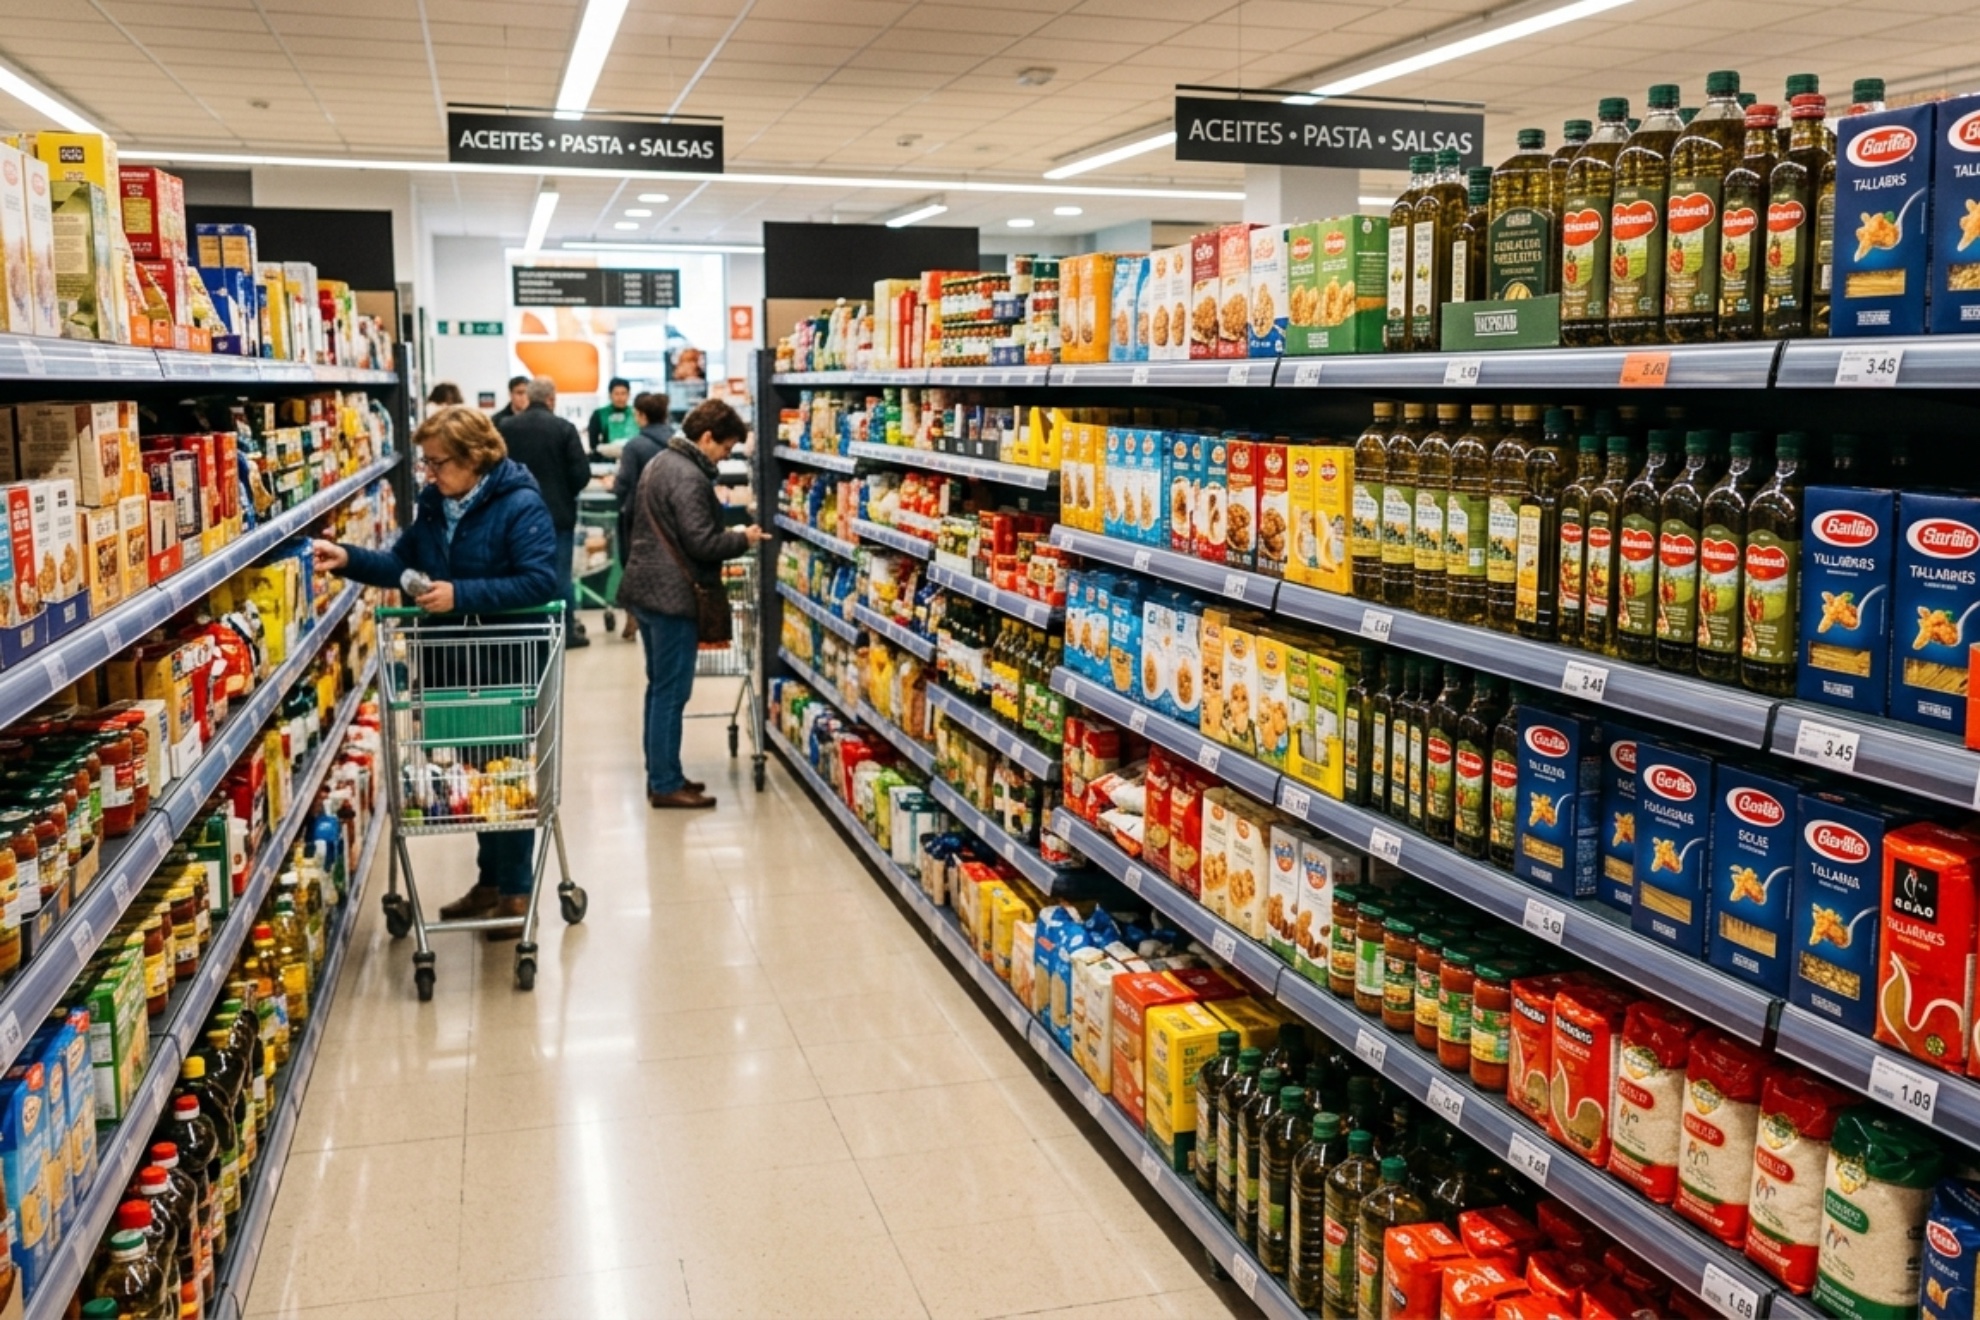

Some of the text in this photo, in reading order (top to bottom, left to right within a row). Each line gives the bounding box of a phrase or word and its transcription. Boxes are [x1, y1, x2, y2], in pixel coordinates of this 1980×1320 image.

[459, 130, 714, 159] ACEITES PASTA SALSAS
[1188, 118, 1472, 154] ACEITES PASTA SALSAS
[1824, 740, 1853, 762] 3.45
